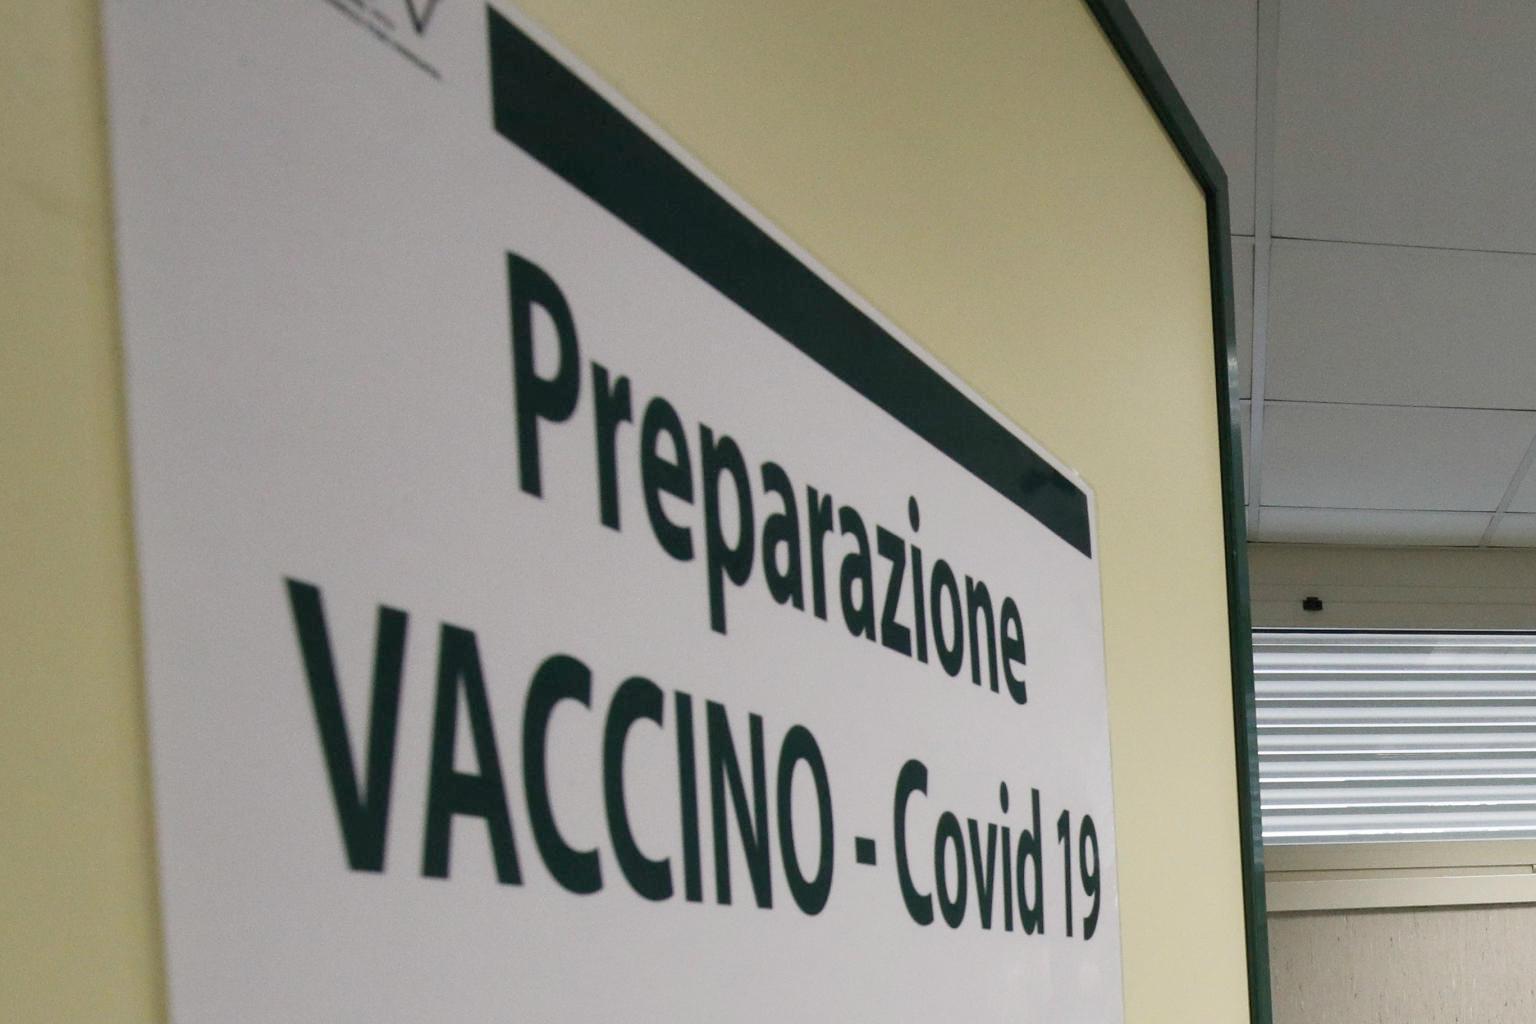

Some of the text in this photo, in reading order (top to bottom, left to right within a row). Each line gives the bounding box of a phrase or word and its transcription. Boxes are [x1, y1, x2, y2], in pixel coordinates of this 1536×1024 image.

[506, 250, 1028, 706] Preparazione
[284, 576, 834, 916] VACCINO
[893, 758, 1046, 937] Covid
[1057, 809, 1101, 941] 19
